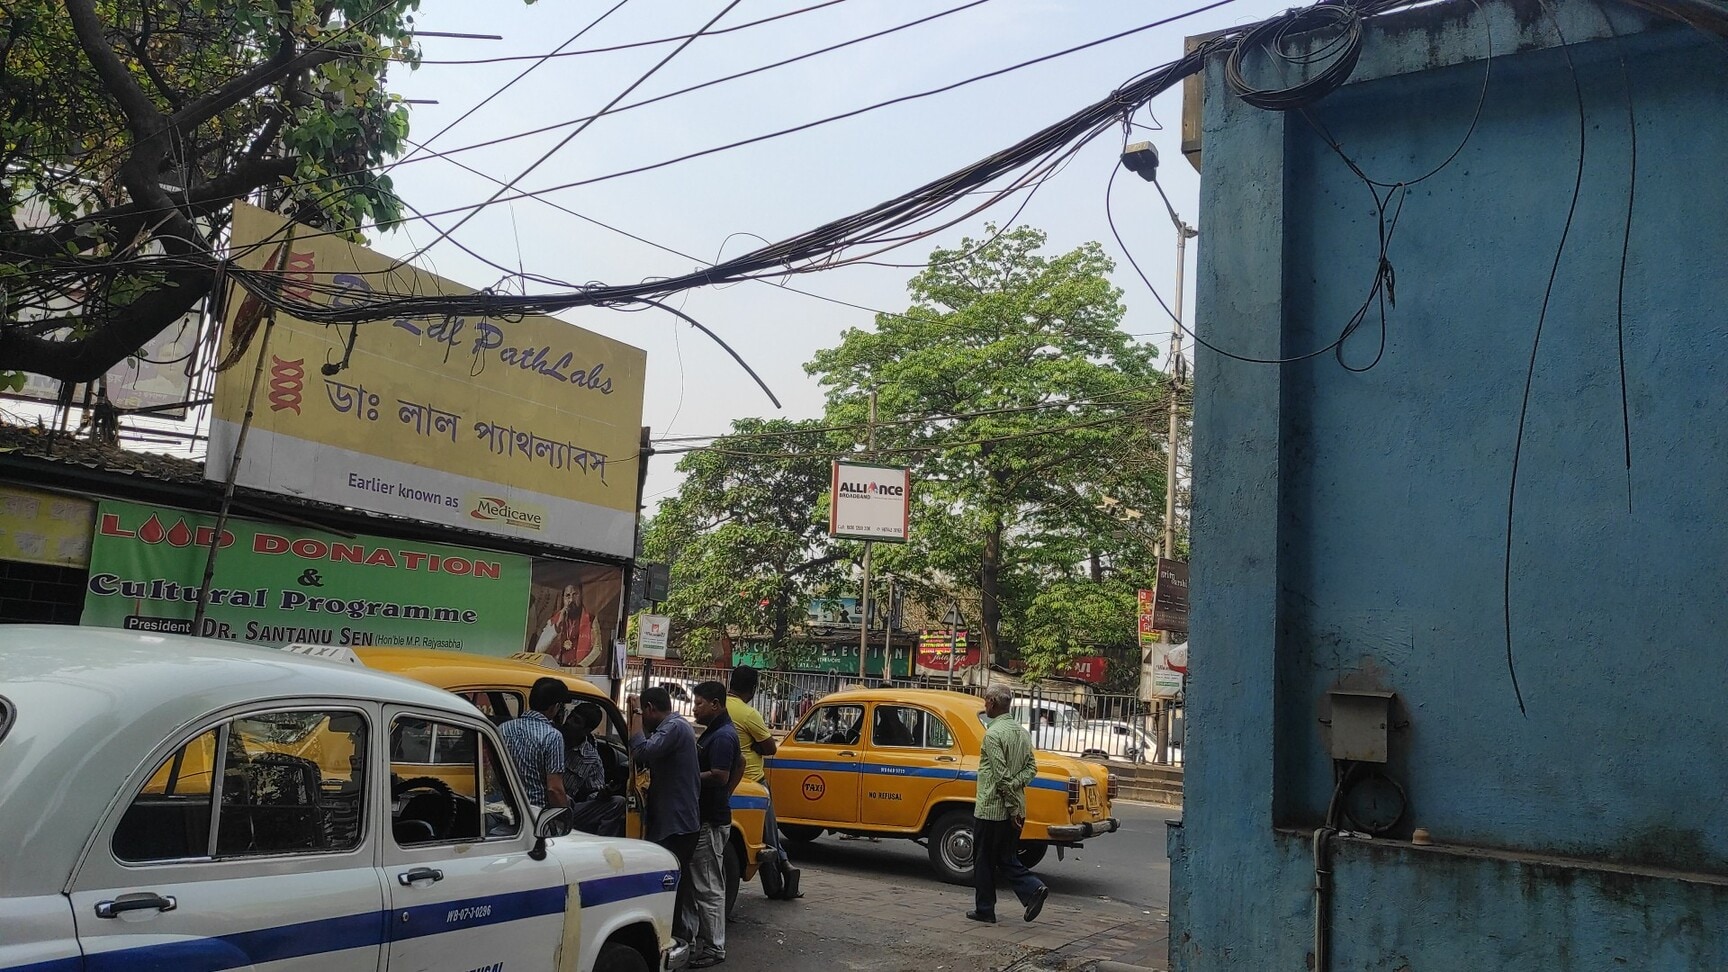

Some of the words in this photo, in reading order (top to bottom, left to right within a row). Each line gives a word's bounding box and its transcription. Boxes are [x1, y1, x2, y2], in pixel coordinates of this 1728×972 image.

[324, 379, 380, 421] ডাঃ
[396, 399, 462, 443] লাল
[348, 472, 395, 495] Earlier
[398, 483, 442, 505] known
[445, 496, 459, 508] as
[478, 500, 541, 524] Medicave
[252, 533, 502, 580] DONATION
[297, 568, 325, 587] &
[88, 572, 269, 608] Cultural
[280, 589, 478, 623] Programme
[129, 618, 191, 634] President
[202, 617, 237, 639] DR.
[245, 620, 333, 644] SANTANU
[339, 627, 373, 647] SEN
[406, 635, 421, 647] M.P.
[422, 636, 464, 650] Rajyasabha)
[290, 645, 340, 657] TAXI
[510, 652, 543, 661] TAXI
[868, 791, 877, 799] NO
[879, 792, 903, 801] REFUSAL
